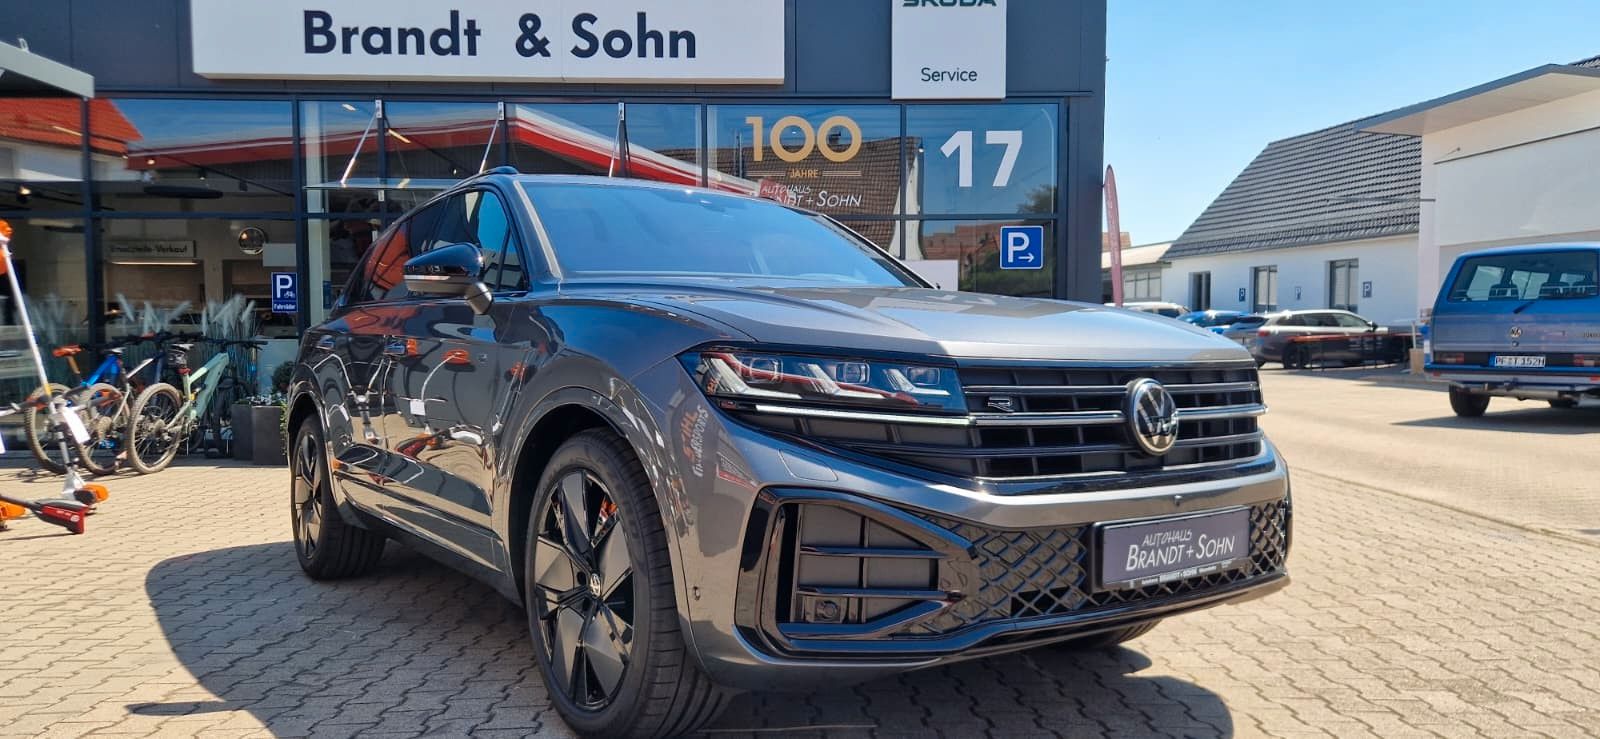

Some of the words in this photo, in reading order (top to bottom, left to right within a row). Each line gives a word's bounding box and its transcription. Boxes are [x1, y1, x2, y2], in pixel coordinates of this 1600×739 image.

[303, 10, 481, 56] Brandt
[515, 13, 551, 58] &
[570, 12, 697, 59] Sohn
[921, 67, 978, 82] Service
[745, 116, 862, 162] 100
[940, 130, 1023, 187] 17
[790, 169, 819, 178] JAHRE
[761, 183, 811, 195] AUTOHAUS
[816, 190, 862, 207] SOHN
[1007, 232, 1030, 263] P
[276, 274, 293, 299] P
[1142, 528, 1193, 548] AUTOHAUS
[1125, 544, 1186, 571] BRANDT
[1195, 533, 1236, 560] SOHN
